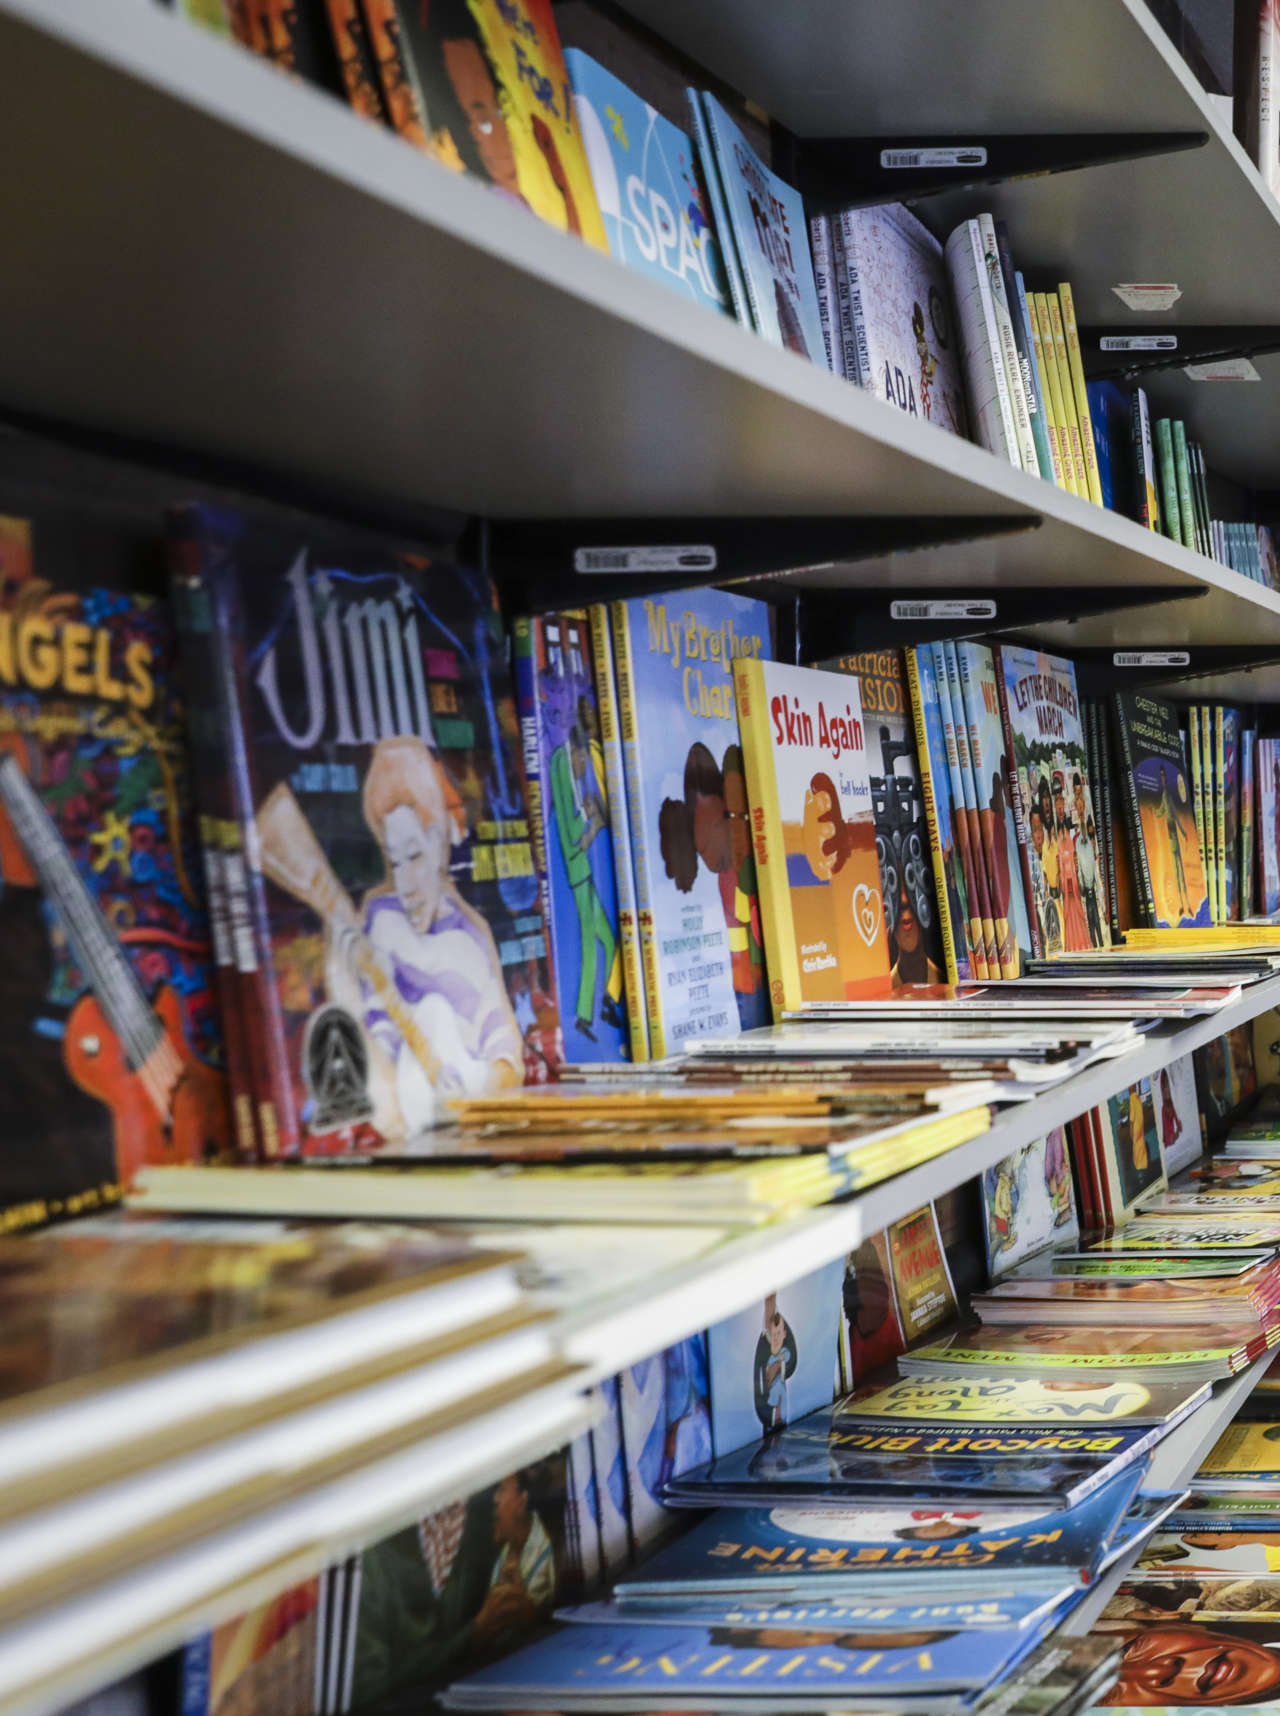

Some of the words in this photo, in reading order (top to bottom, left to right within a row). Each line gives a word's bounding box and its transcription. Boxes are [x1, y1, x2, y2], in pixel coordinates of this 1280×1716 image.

[885, 360, 918, 416] ADA
[643, 601, 680, 669] My
[1013, 677, 1031, 712] LET
[521, 717, 540, 773] HARLEM
[771, 694, 814, 748] Skin
[818, 701, 864, 760] Again
[922, 1436, 1124, 1454] Boycott
[707, 1528, 1064, 1563] KATHERINE
